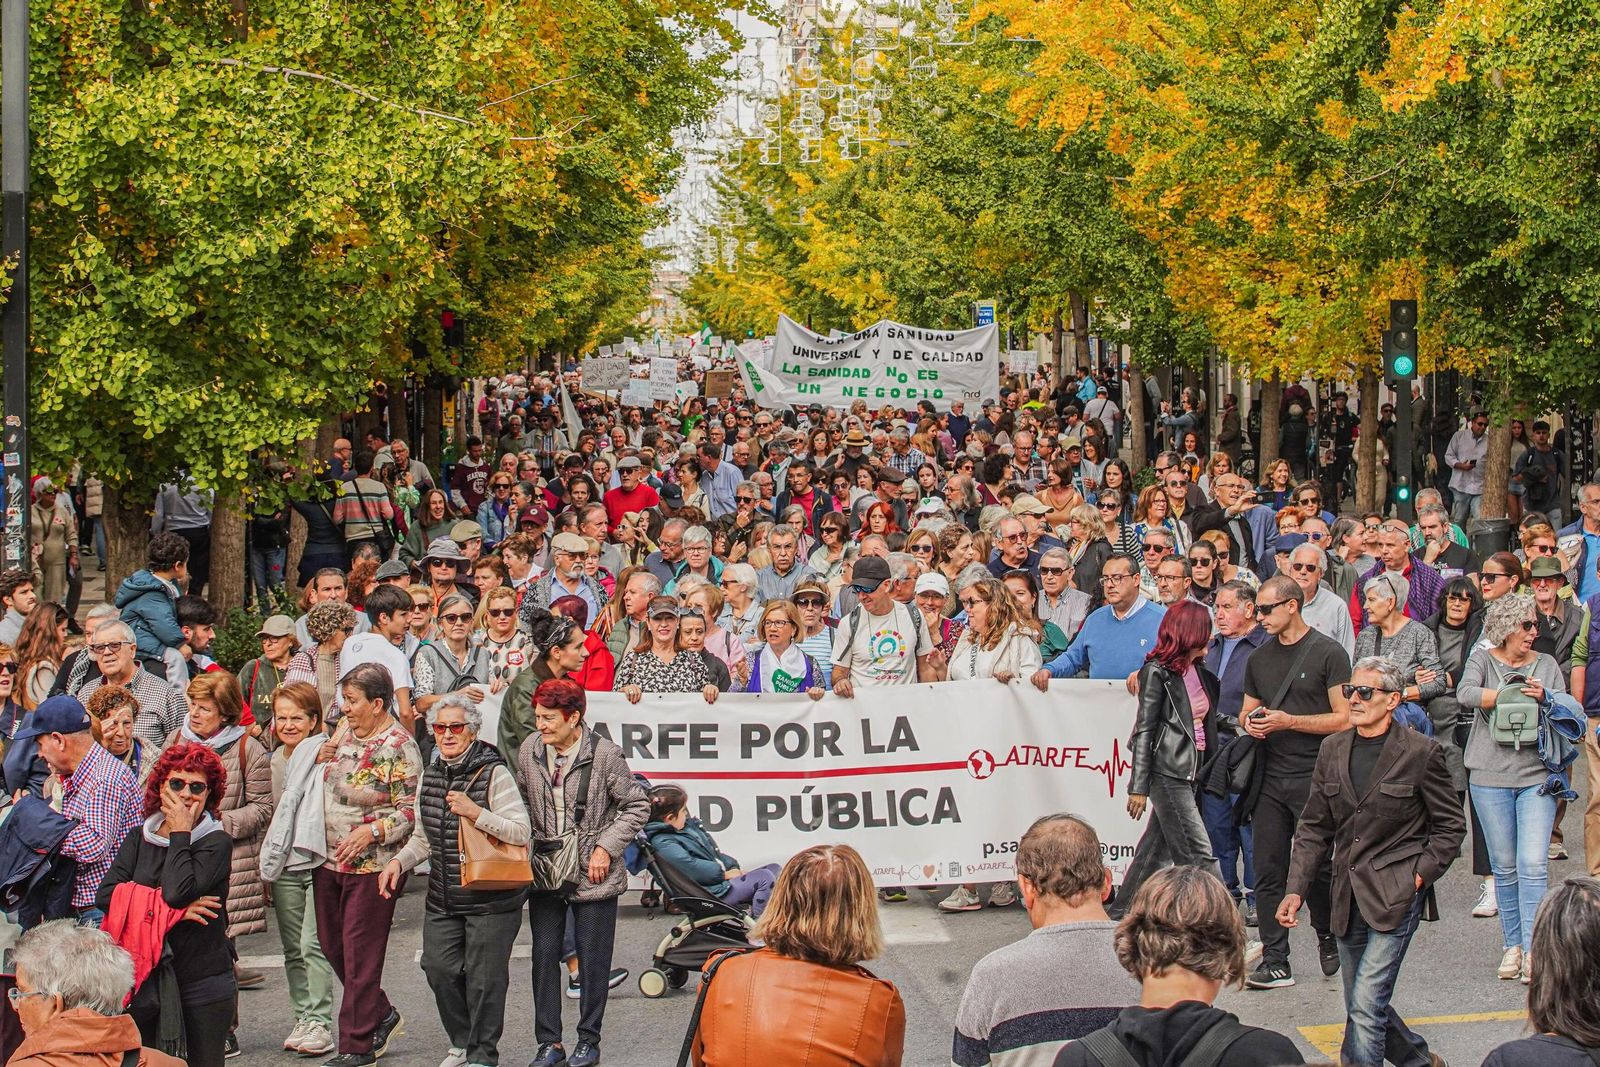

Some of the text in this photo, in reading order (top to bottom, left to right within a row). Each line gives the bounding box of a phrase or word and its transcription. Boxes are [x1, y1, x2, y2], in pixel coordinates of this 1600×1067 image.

[888, 328, 954, 341] SANIDAD
[792, 346, 984, 362] UNIVERSAL Y DE CALIDAD
[782, 362, 938, 383] LA SANIDAD NO ES
[798, 383, 944, 398] UN NEGOCIO
[740, 720, 844, 759] POR
[860, 716, 920, 754] LA
[1005, 746, 1089, 768] ATARFE
[756, 786, 962, 832] PÚBLICA
